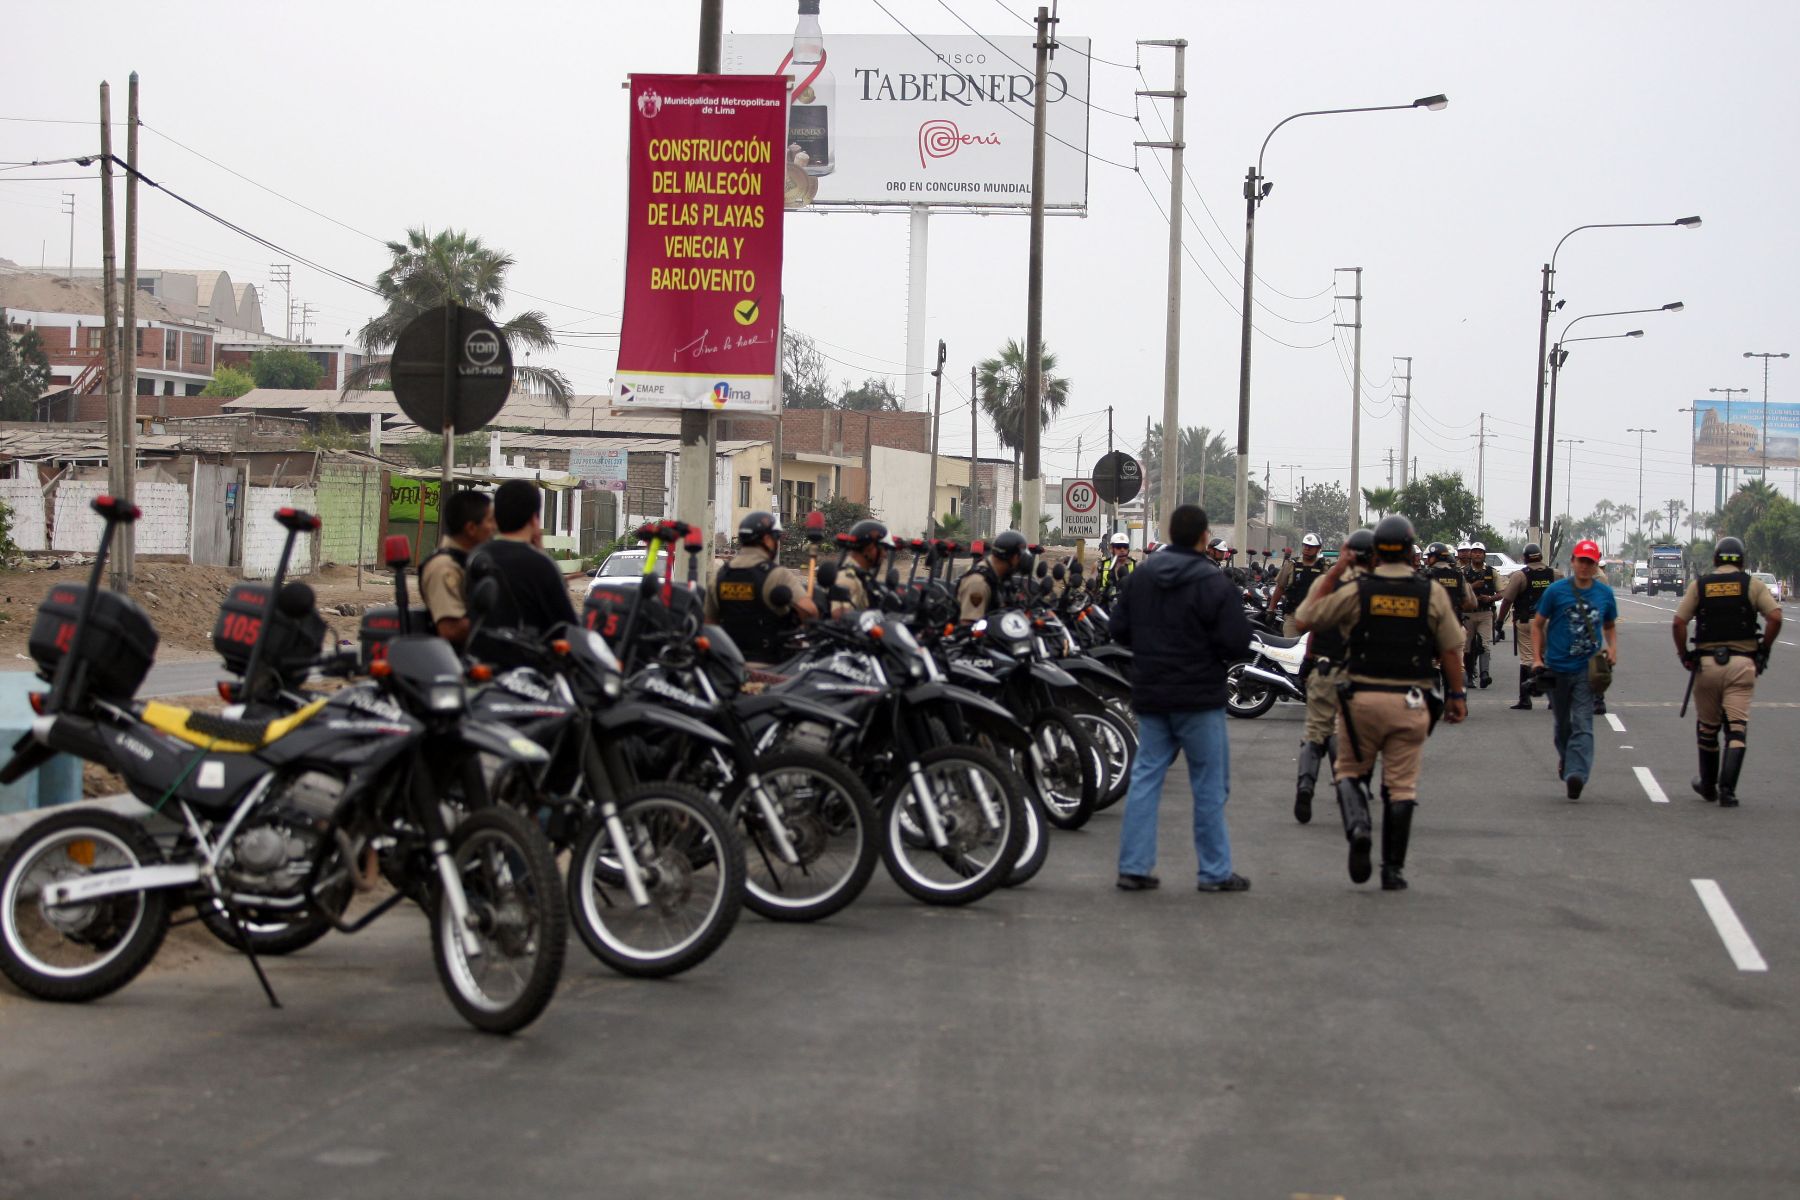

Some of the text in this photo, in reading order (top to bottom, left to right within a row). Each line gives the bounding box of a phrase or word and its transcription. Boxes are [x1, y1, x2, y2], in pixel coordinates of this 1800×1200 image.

[937, 54, 987, 64] PISCO
[854, 67, 1068, 107] TABERNERO
[664, 96, 780, 108] Municipalidad Metropolitana
[702, 106, 735, 115] de Lima
[649, 136, 771, 163] CONSTRUCCIÓN
[653, 168, 761, 195] DEL MALECÓN
[886, 181, 1032, 193] ORO EN CONCURSO MUNDIAL
[648, 203, 765, 228] DE LAS PLAYAS
[665, 235, 745, 260] VENECIA Y
[651, 267, 756, 293] BARLOVENTO
[635, 384, 665, 395] EMAPE
[1072, 488, 1090, 503] 60
[1065, 515, 1098, 524] VELOCIDAD
[1068, 526, 1093, 535] MAXIMA
[223, 612, 262, 646] 105
